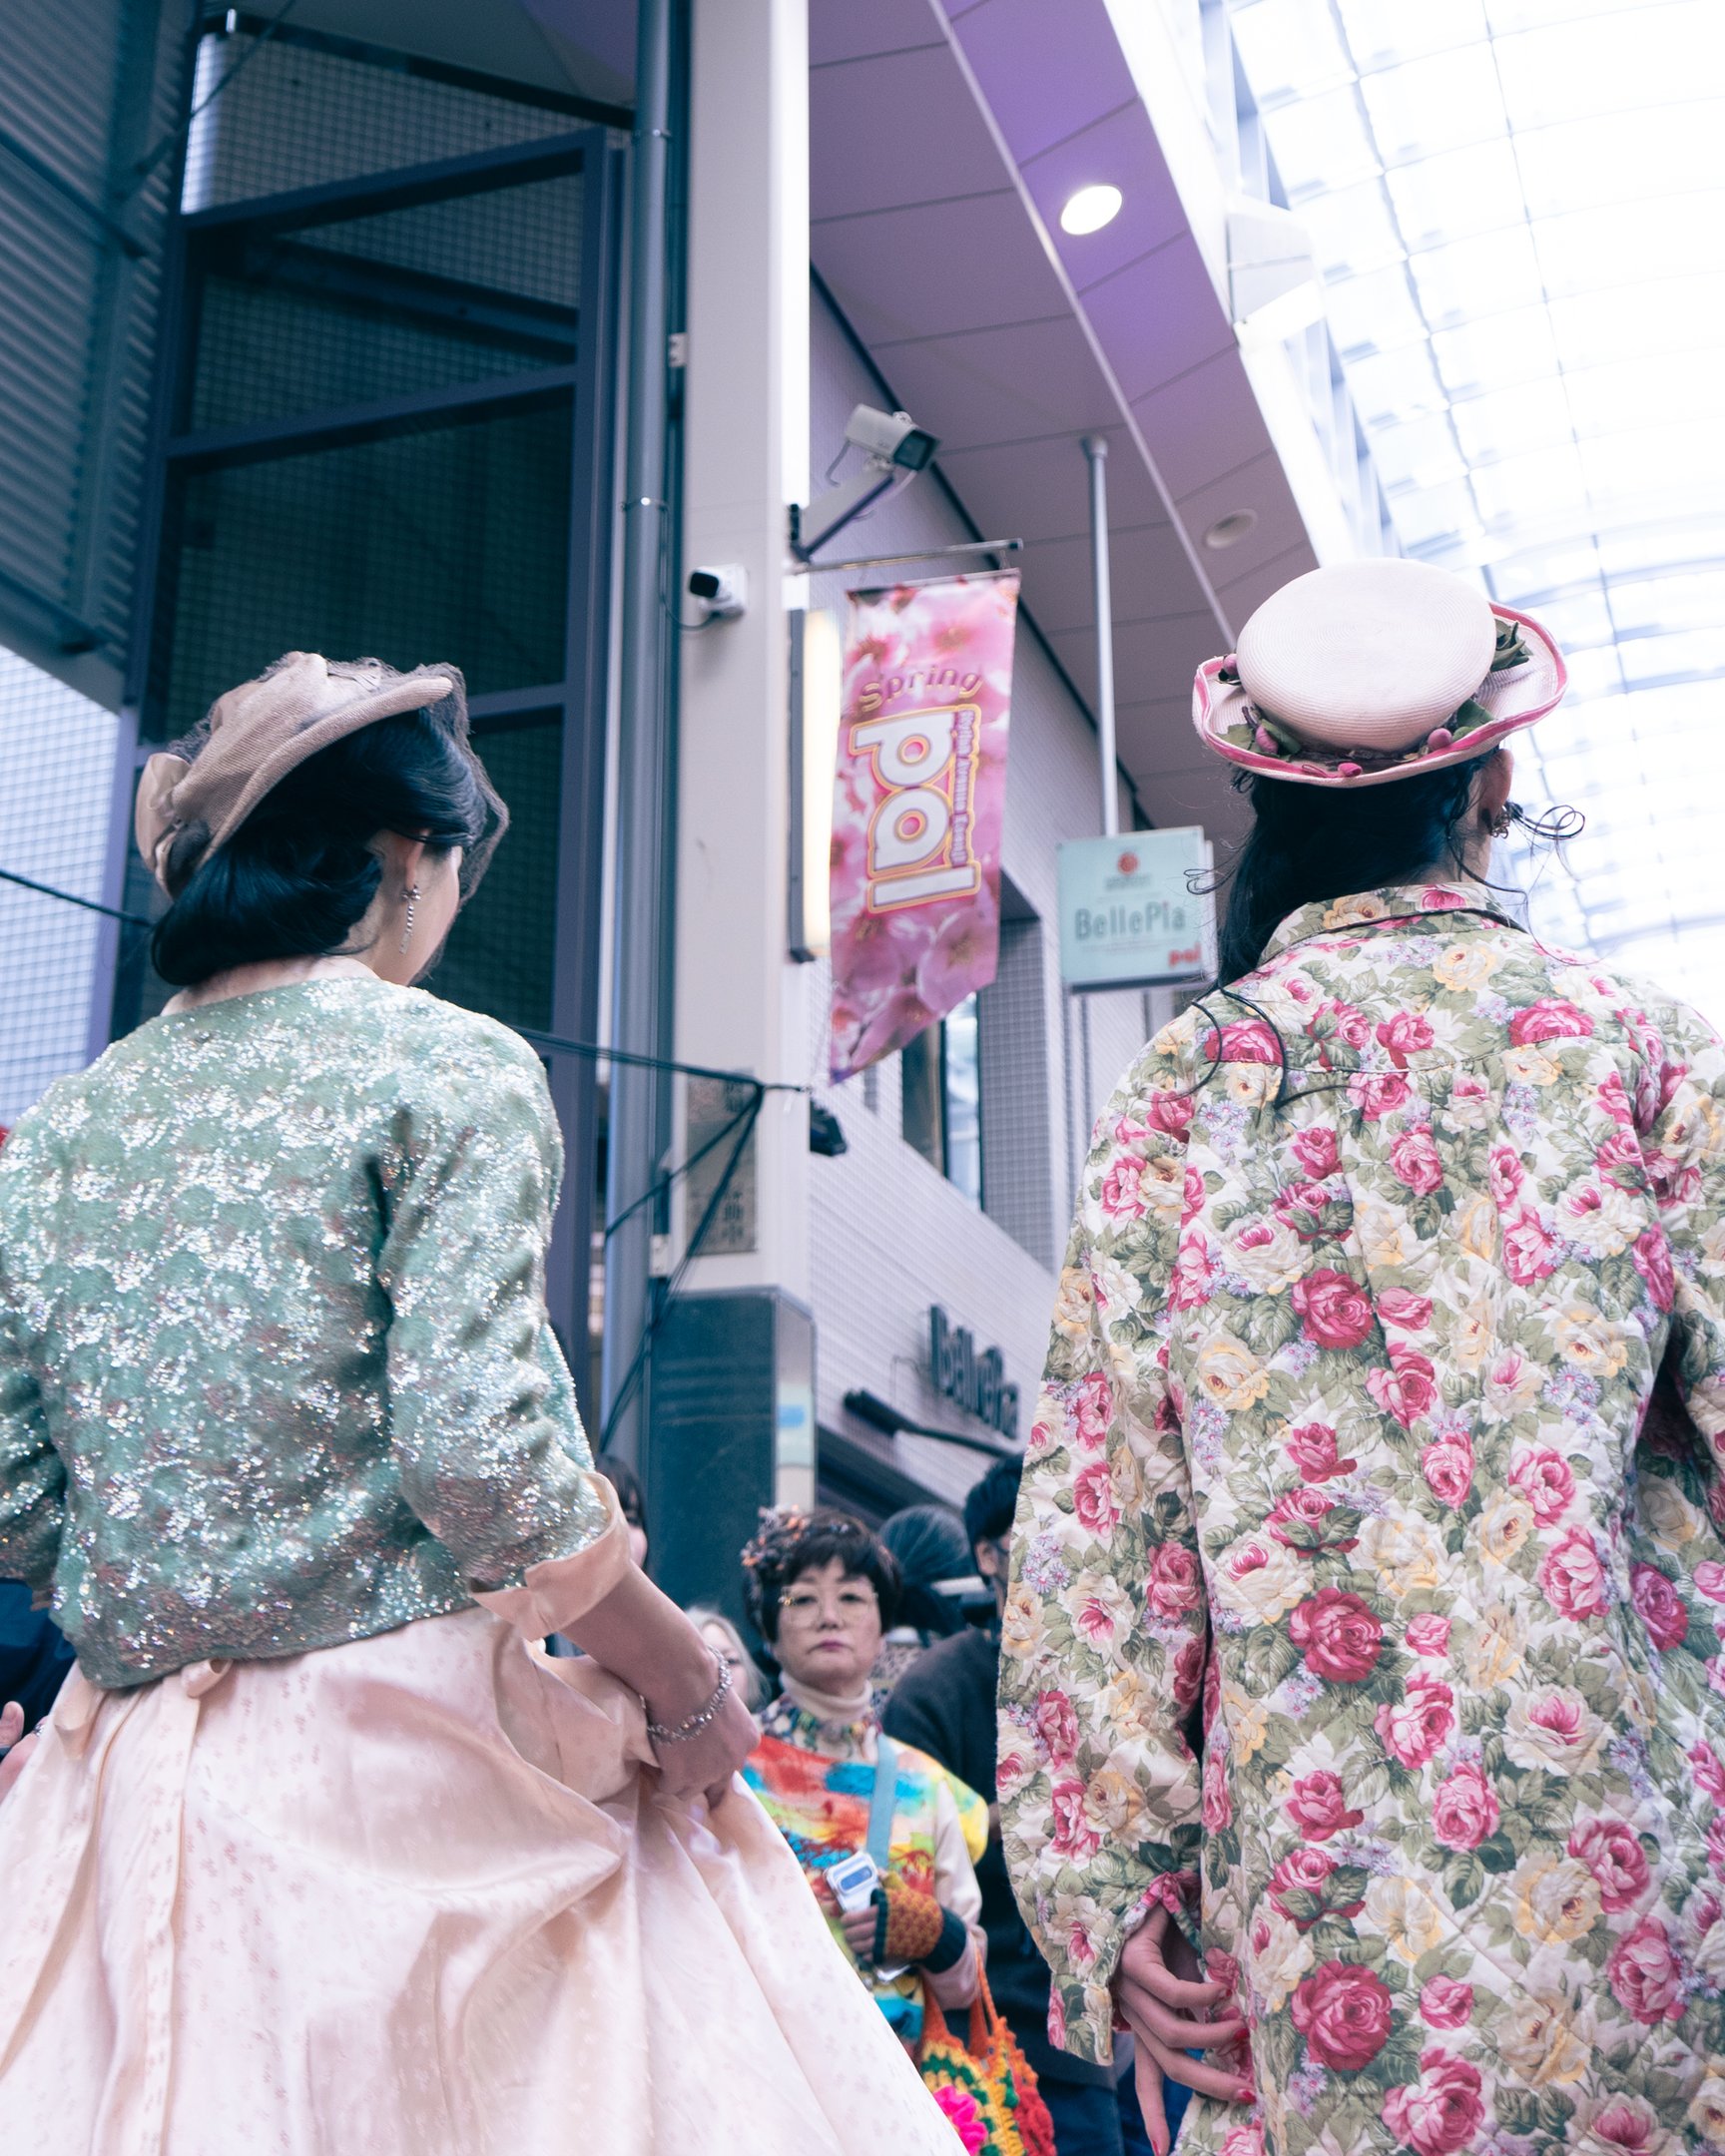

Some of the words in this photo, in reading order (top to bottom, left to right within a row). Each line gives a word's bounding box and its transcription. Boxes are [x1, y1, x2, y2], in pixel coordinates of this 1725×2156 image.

[860, 665, 982, 713] Spring
[852, 707, 979, 910] pal
[1074, 900, 1185, 941] BellePia
